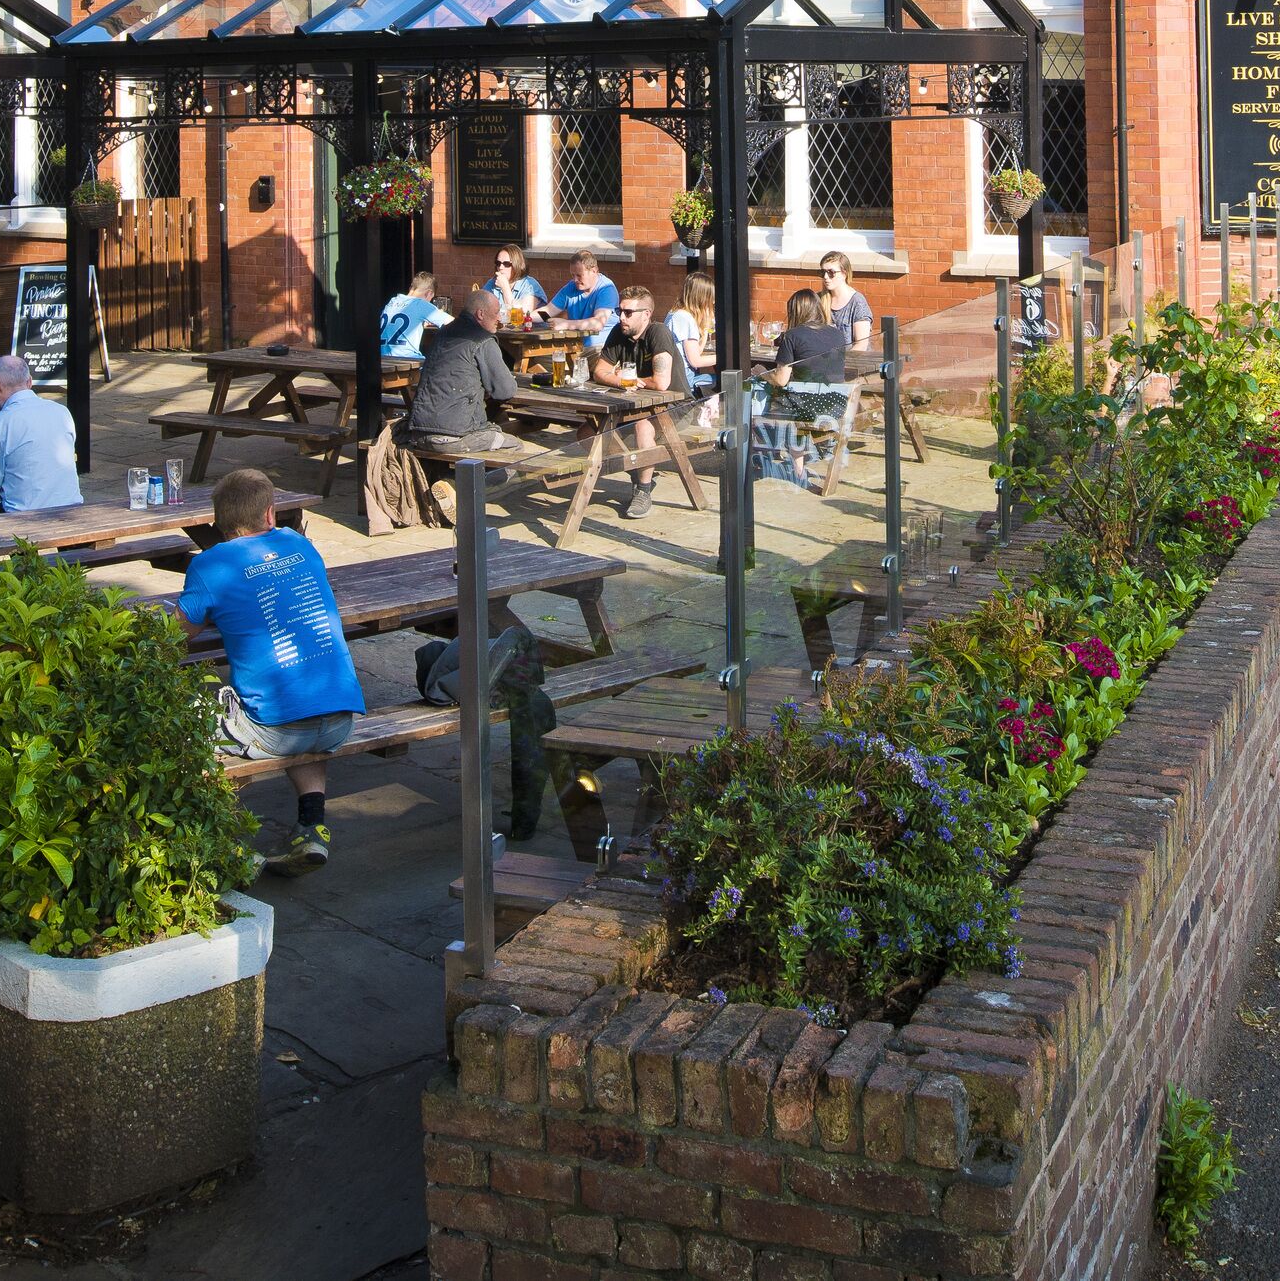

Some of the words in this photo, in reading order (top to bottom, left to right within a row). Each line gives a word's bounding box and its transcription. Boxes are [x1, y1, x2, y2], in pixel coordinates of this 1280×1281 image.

[1226, 12, 1274, 26] LIVE
[468, 126, 487, 134] ALL
[490, 125, 508, 134] DAY
[477, 149, 501, 158] LIVE
[468, 160, 509, 169] SPORTS
[465, 185, 513, 194] FAMILIES
[464, 196, 516, 206] WELCOME
[462, 221, 489, 231] CASK
[492, 221, 518, 231] ALES
[23, 304, 67, 319] FUNCTI
[248, 555, 301, 576] INDEPENDENT
